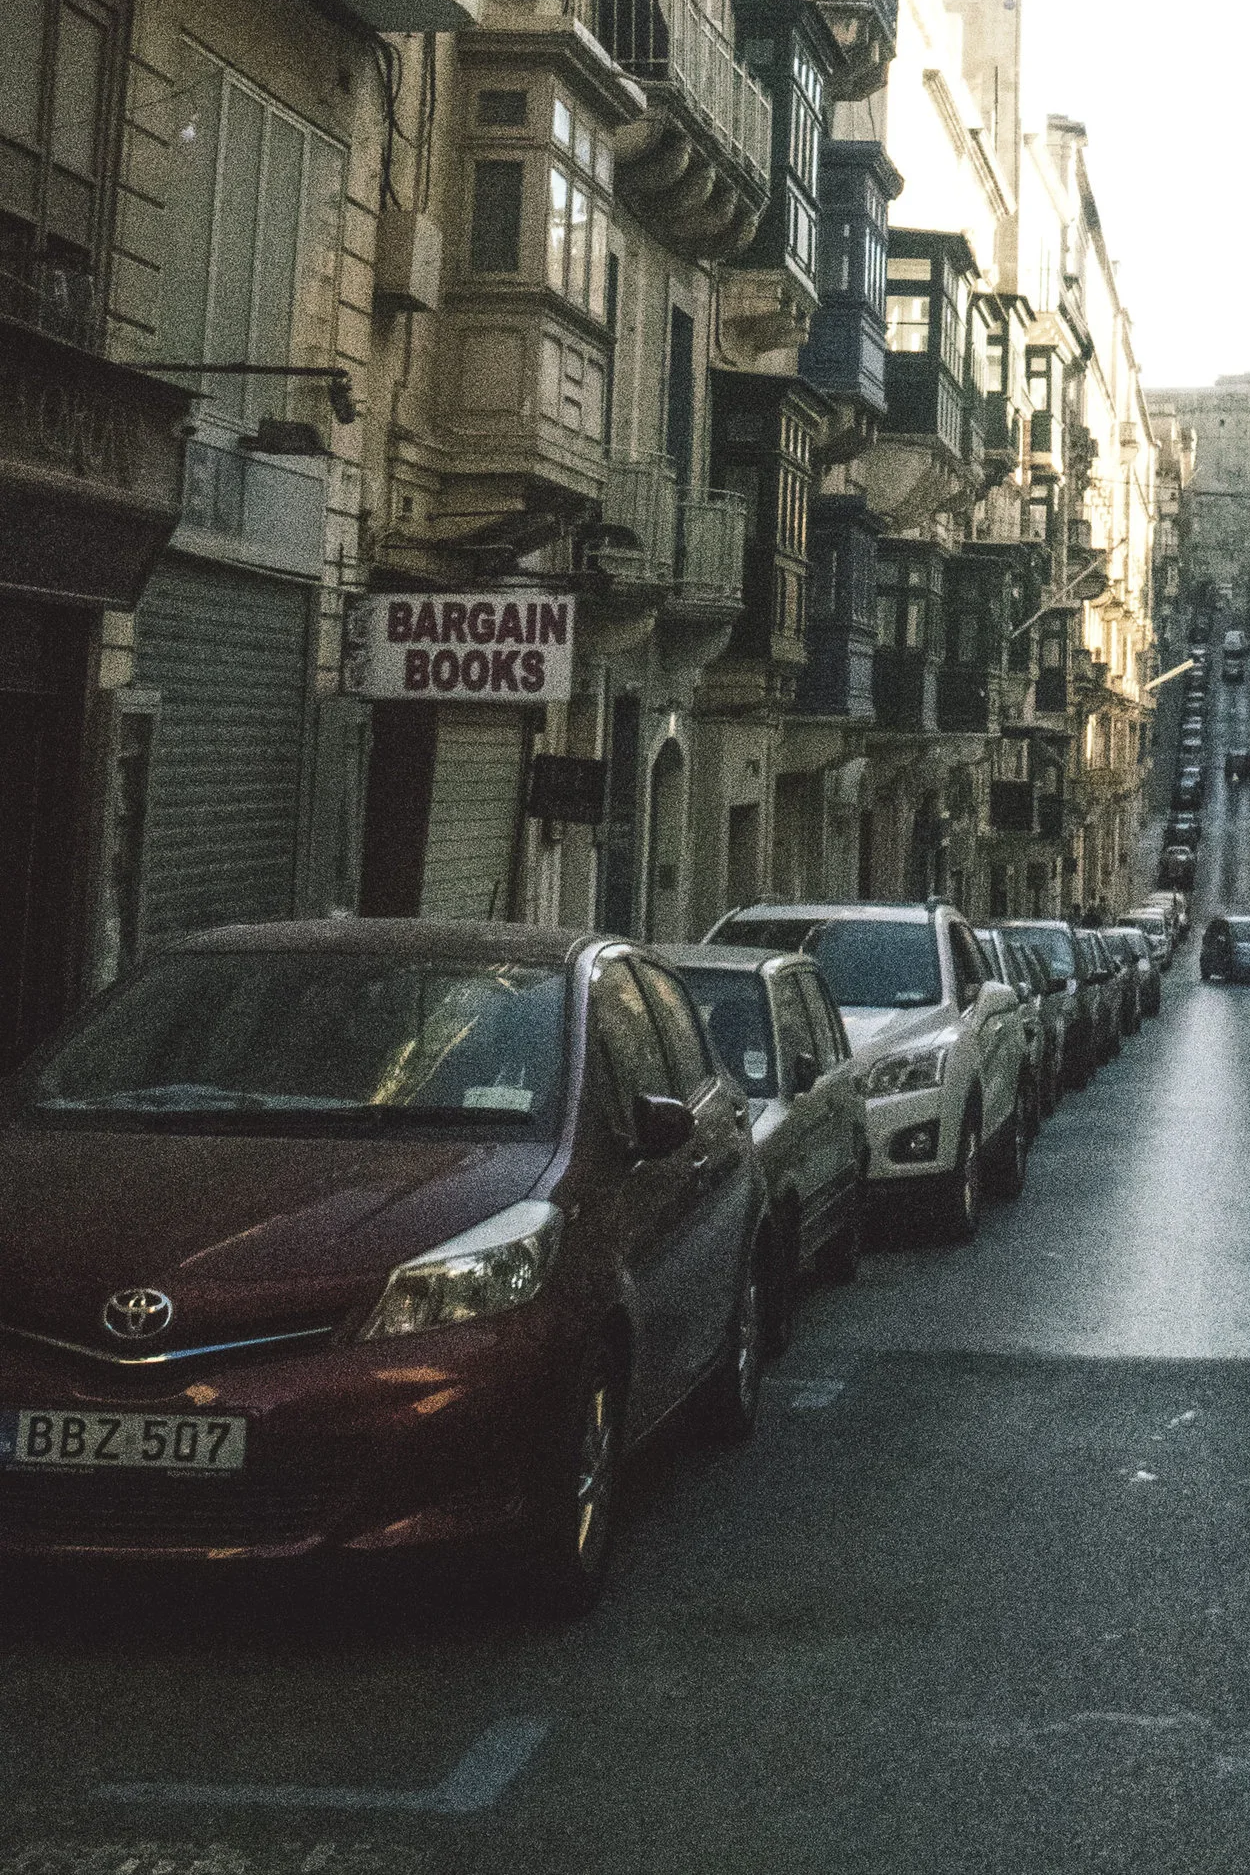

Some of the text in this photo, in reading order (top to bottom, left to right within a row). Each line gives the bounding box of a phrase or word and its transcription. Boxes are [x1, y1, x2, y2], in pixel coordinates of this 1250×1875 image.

[387, 601, 568, 644] BARGAIN
[403, 648, 546, 692] BOOKS
[27, 1415, 231, 1464] BBZ 507
